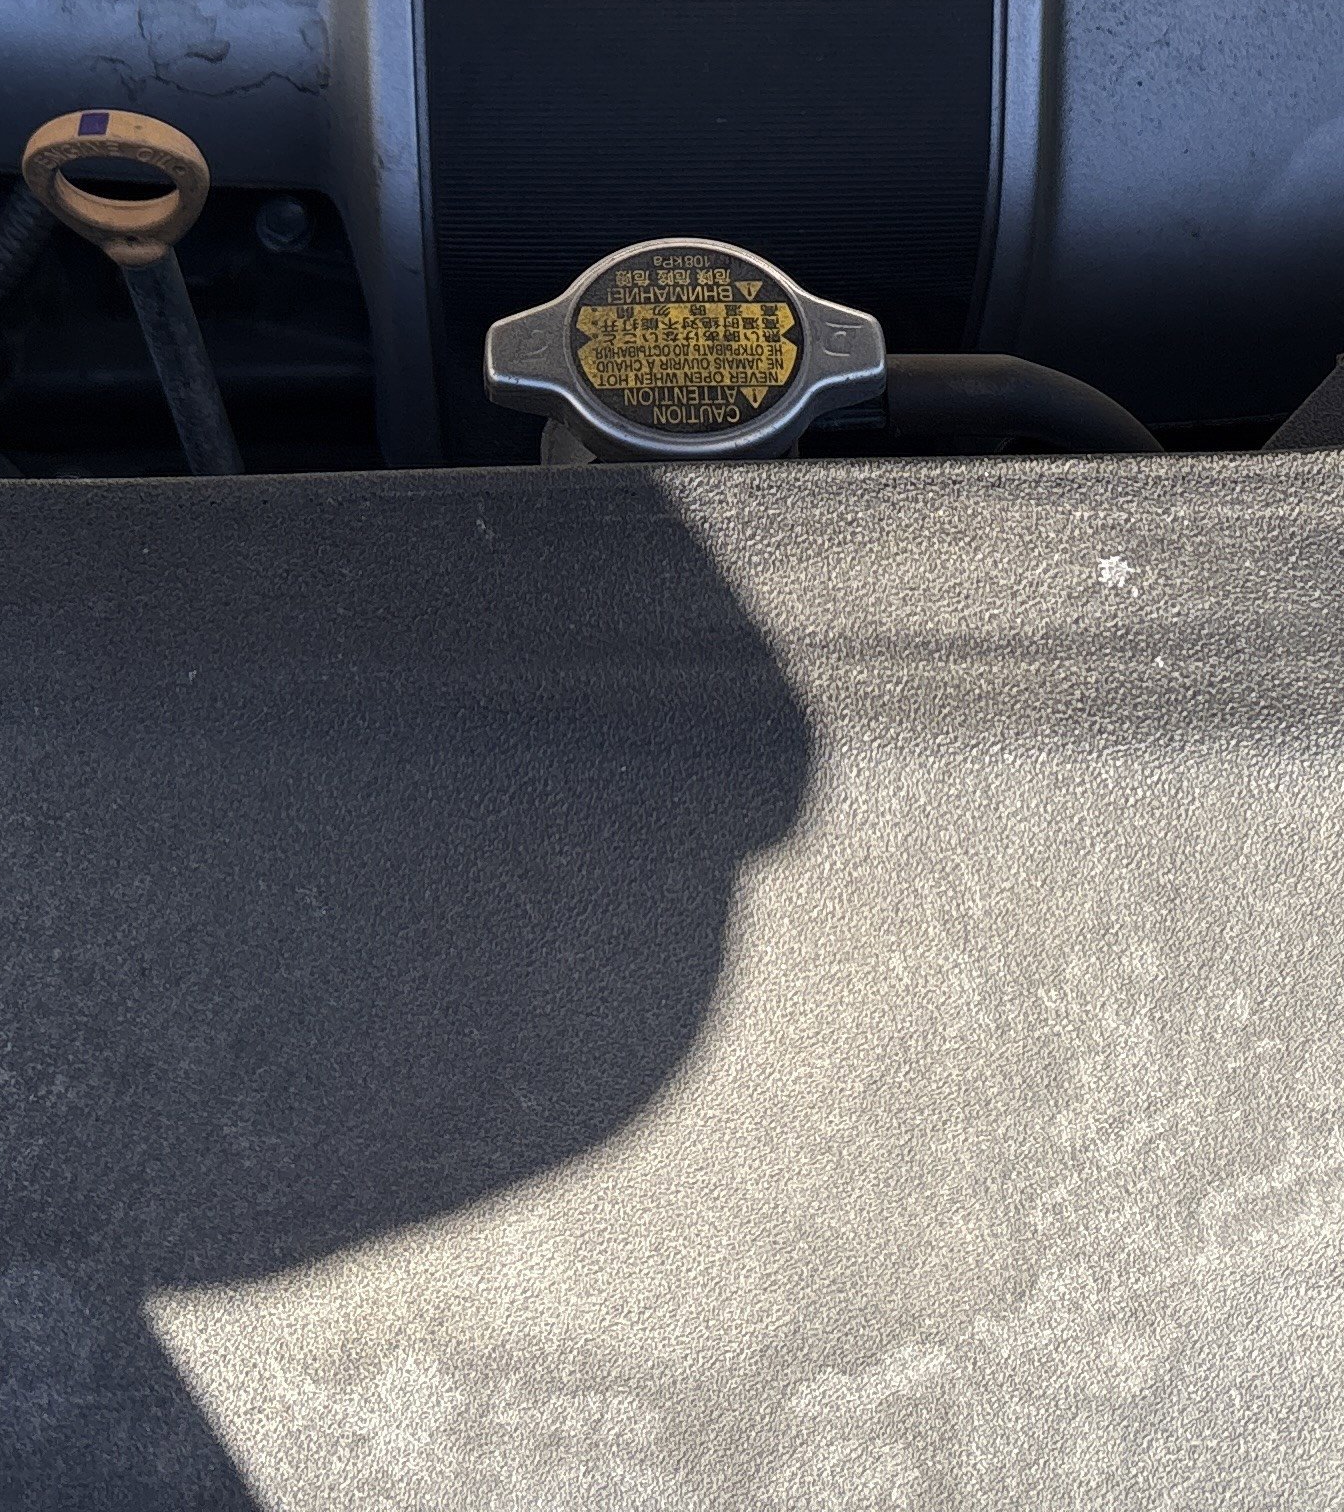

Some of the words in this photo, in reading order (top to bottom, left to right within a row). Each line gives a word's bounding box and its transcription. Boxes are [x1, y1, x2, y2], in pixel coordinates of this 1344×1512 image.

[33, 138, 122, 170] ENGINE
[606, 285, 732, 302] ВНИМАНИЕ!
[673, 342, 690, 356] ДО
[693, 343, 764, 356] ОТКРЫВАТЬ
[766, 344, 782, 355] НЕ
[659, 358, 710, 370] OUVRIR
[713, 357, 762, 370] JAMAIS
[767, 357, 783, 368] NE
[634, 372, 677, 385] WHEN
[683, 370, 723, 383] OPEN
[728, 370, 778, 383] NEVER
[623, 386, 737, 405] ATTENTION
[652, 405, 739, 423] CAUTION
